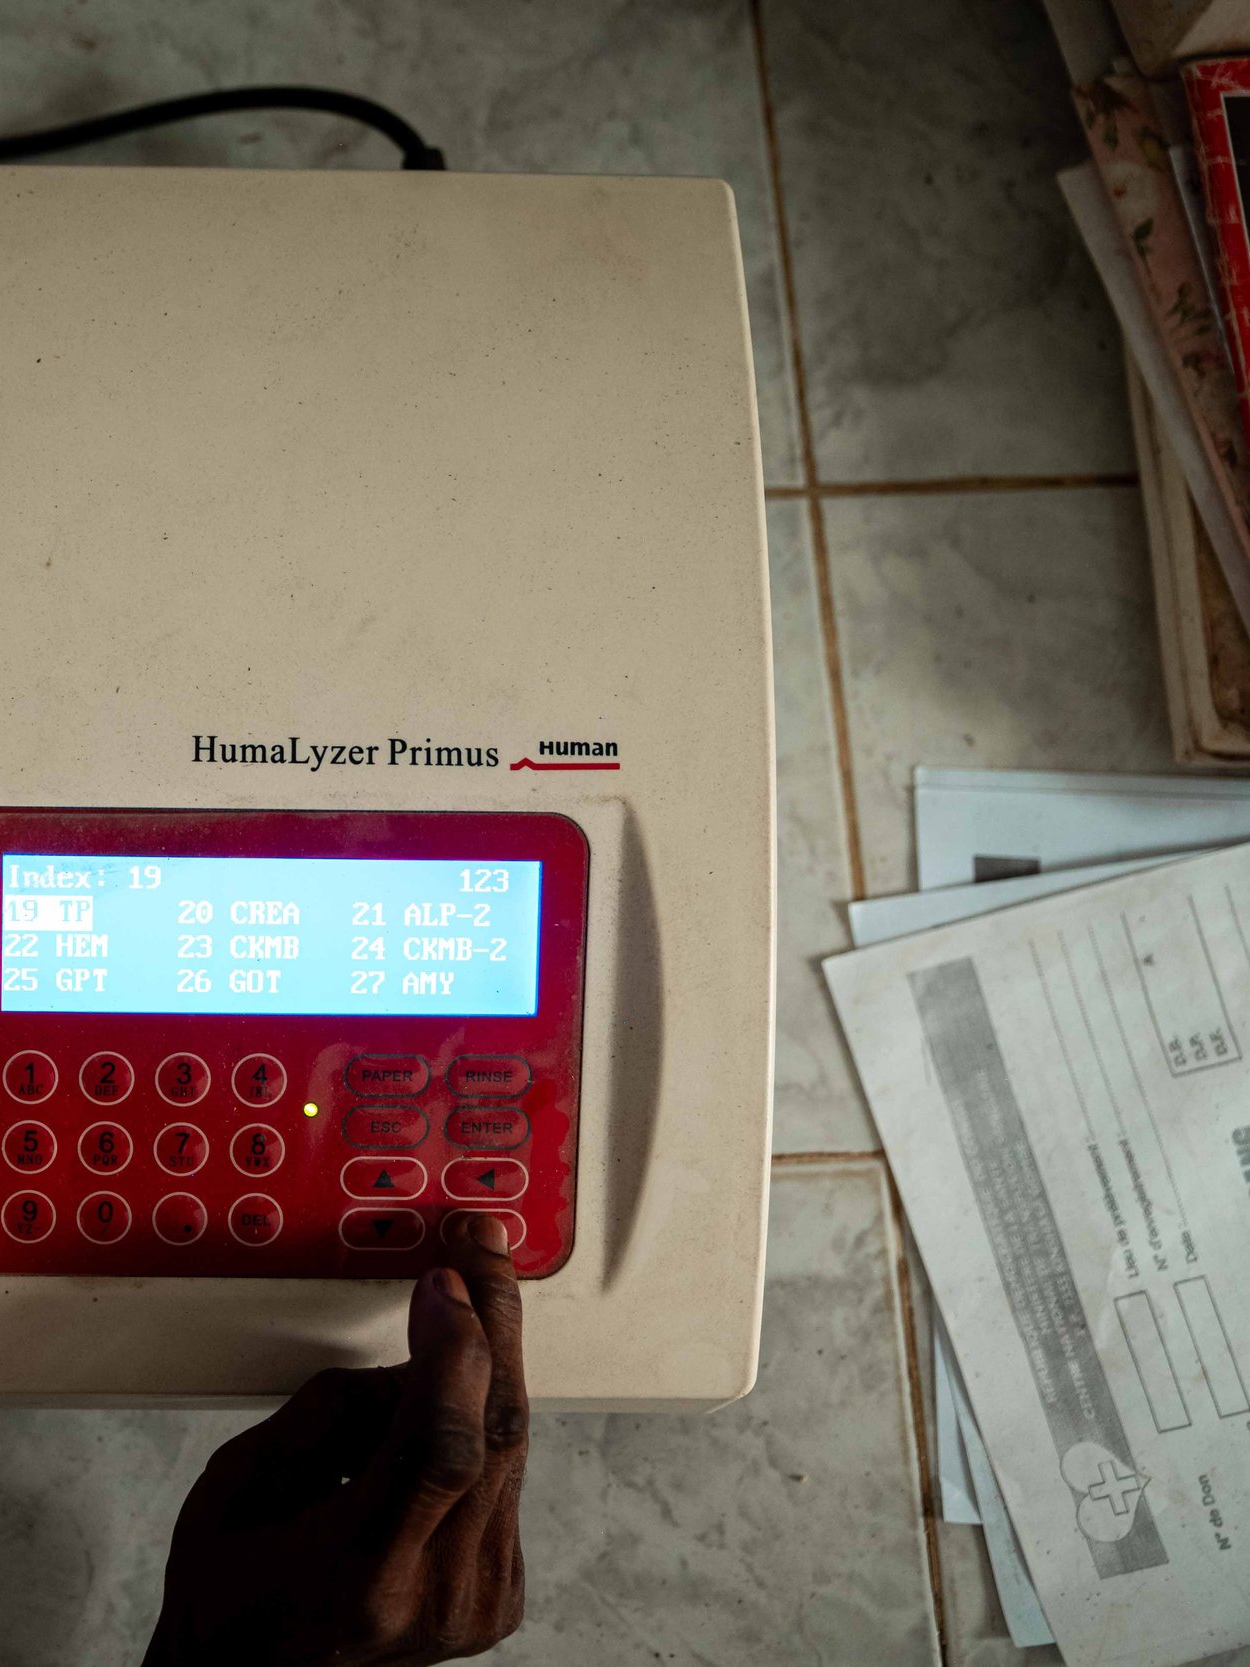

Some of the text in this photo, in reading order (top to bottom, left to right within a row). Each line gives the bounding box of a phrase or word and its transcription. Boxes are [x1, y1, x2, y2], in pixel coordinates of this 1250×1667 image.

[191, 734, 500, 772] HumaLyzer Primus
[538, 740, 619, 757] Human
[9, 864, 161, 889] Index: 19
[459, 868, 509, 892] 123
[7, 900, 90, 922] 19 TP
[177, 900, 300, 925] 20 CREA
[351, 902, 491, 927] 21 ALP-2
[4, 933, 109, 958] 22 HEM
[177, 934, 300, 960] 23 CKMB
[351, 936, 508, 961] 24 CKMB-2
[3, 967, 108, 992] 25 GPT
[177, 969, 282, 994] 26 GOT
[350, 970, 454, 995] 27 AMY
[25, 1062, 35, 1084] 1
[101, 1061, 116, 1084] 2
[177, 1063, 192, 1085] 3
[253, 1063, 268, 1084] 4
[362, 1070, 413, 1082] PAPER
[465, 1070, 513, 1082] RINSE
[18, 1084, 44, 1095] ABC
[94, 1085, 119, 1096] DEF
[370, 1121, 401, 1133] ESC
[461, 1122, 513, 1134] ENTER
[23, 1130, 39, 1152] 5
[99, 1131, 114, 1154] 6
[175, 1132, 190, 1155] 7
[251, 1133, 266, 1156] 8
[17, 1154, 43, 1165] MNO
[93, 1154, 118, 1166] PQR
[169, 1156, 194, 1167] STU
[245, 1156, 271, 1168] VWX
[22, 1200, 38, 1222] 9
[98, 1200, 113, 1223] 0
[241, 1214, 271, 1227] DEL
[1116, 1228, 1129, 1247] de
[1182, 1230, 1198, 1264] Date
[1198, 1474, 1232, 1551] N° de Don
